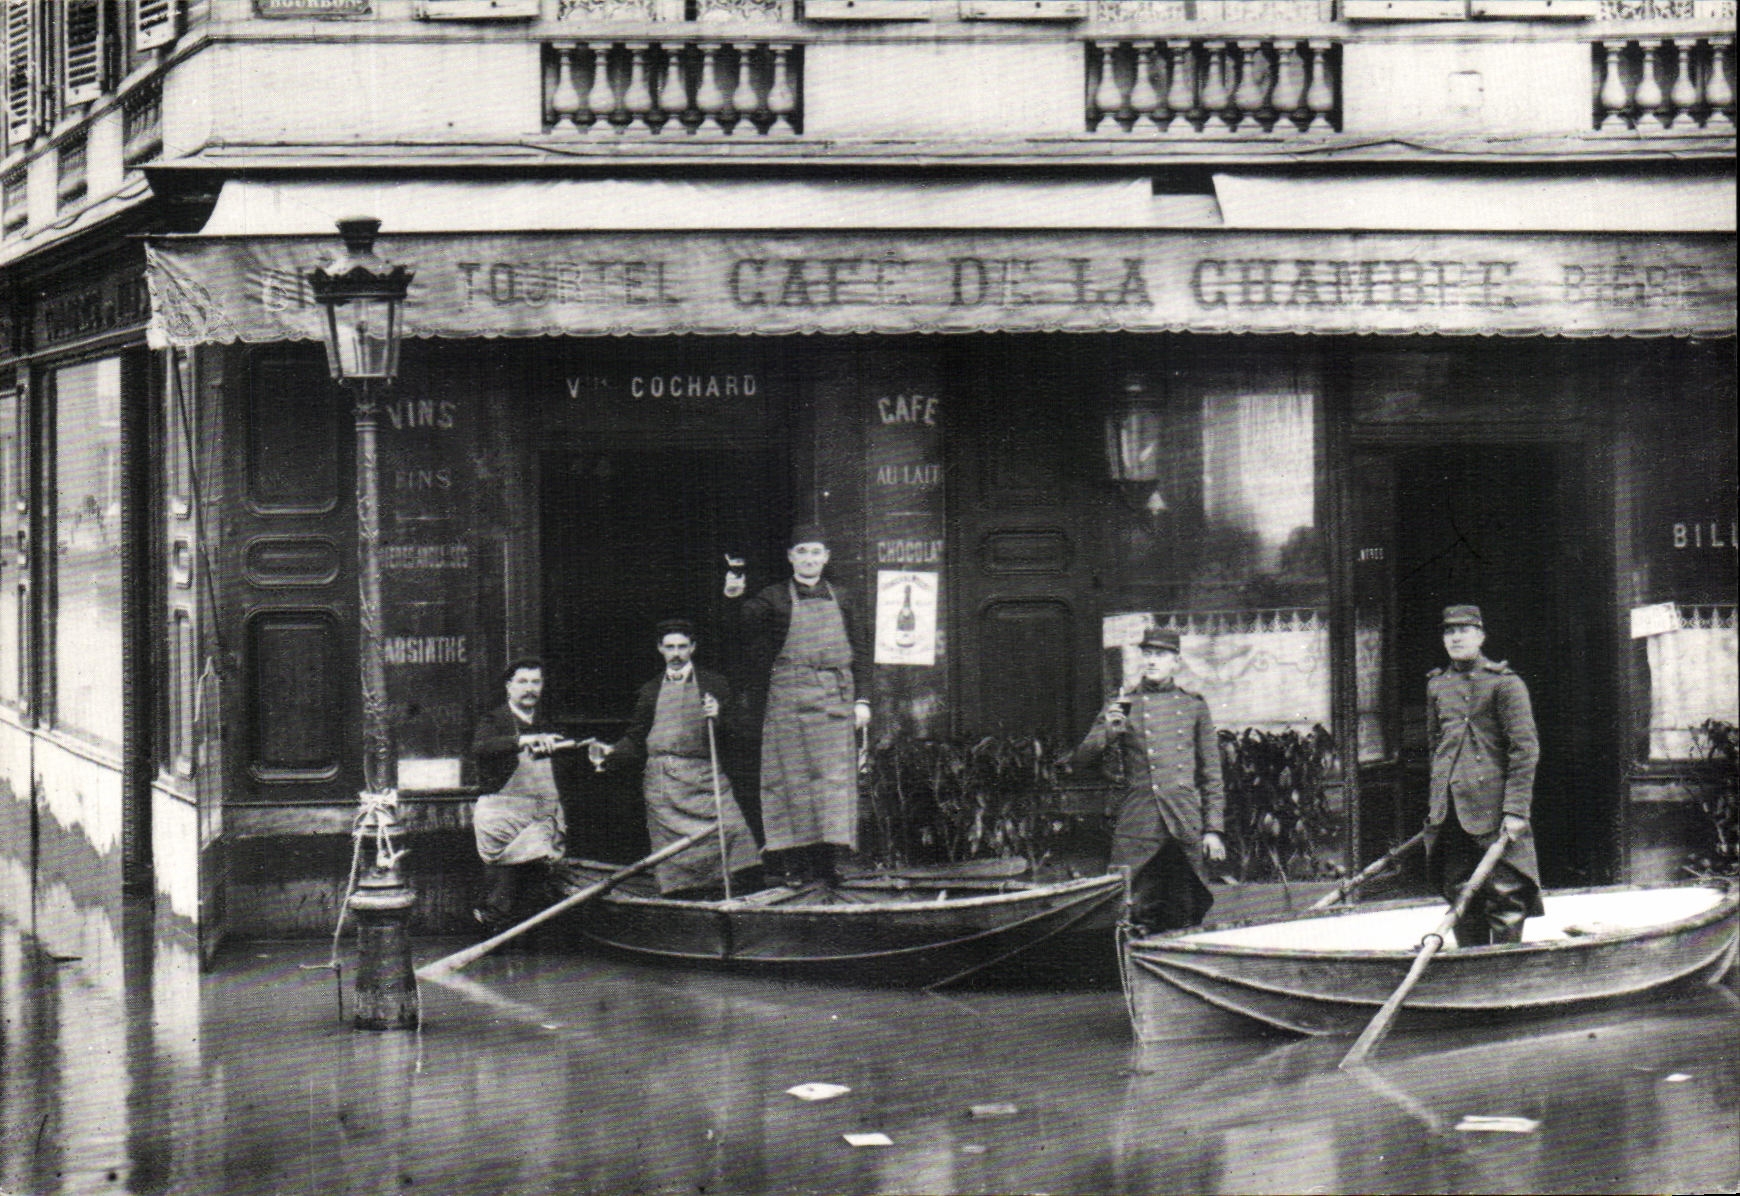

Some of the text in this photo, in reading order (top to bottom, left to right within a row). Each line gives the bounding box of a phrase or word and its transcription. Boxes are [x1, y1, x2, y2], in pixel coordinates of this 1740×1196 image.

[949, 257, 1035, 309] DE
[1067, 257, 1155, 308] LA
[1190, 257, 1518, 311] CHAMBRE
[631, 375, 756, 398] COCHARD
[385, 400, 457, 430] VINS
[876, 464, 941, 486] AU LAIT
[384, 636, 468, 664] ABSINTHE
